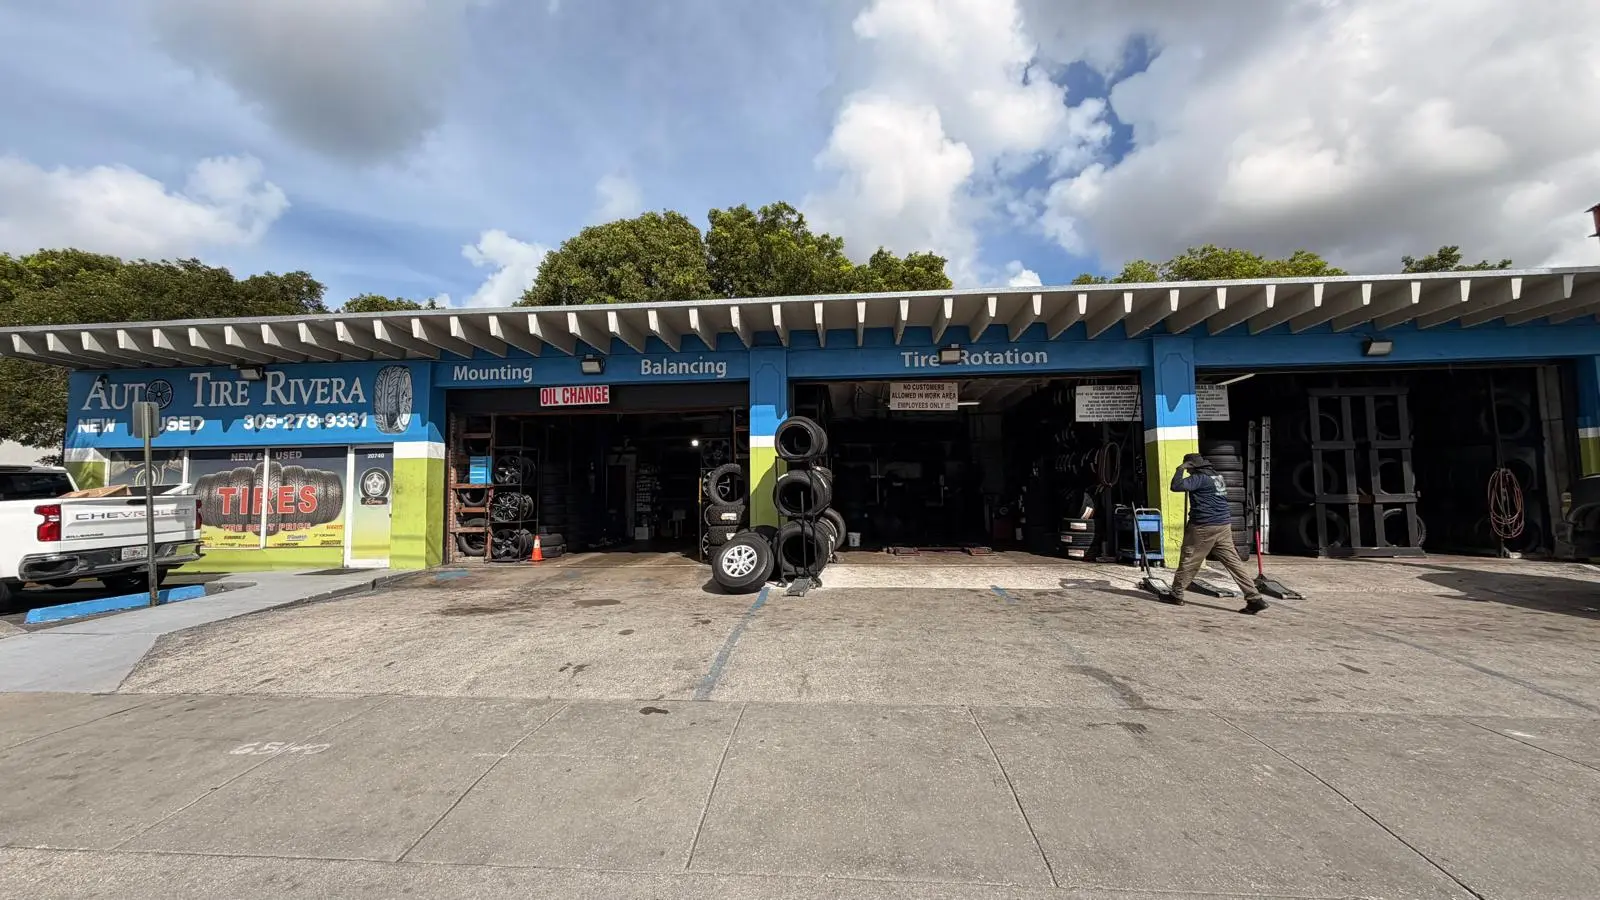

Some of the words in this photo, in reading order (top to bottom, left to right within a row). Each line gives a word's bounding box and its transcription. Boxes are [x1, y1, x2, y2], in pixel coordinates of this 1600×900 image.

[901, 351, 940, 367] Tire
[958, 349, 1048, 366] Rotation
[453, 365, 533, 383] Mounting
[641, 357, 727, 378] Balancing
[189, 372, 250, 408] TIRE
[262, 371, 367, 406] RIVERA
[541, 388, 559, 405] OIL
[562, 386, 609, 404] CHANGE
[912, 383, 945, 391] CUSTOMERS
[941, 391, 957, 399] AREA
[77, 418, 116, 433] NEW
[243, 411, 368, 430] 305-278-9331
[231, 452, 254, 461] NEW
[275, 451, 303, 460] USED
[218, 486, 317, 514] TIRES
[246, 523, 276, 532] BET
